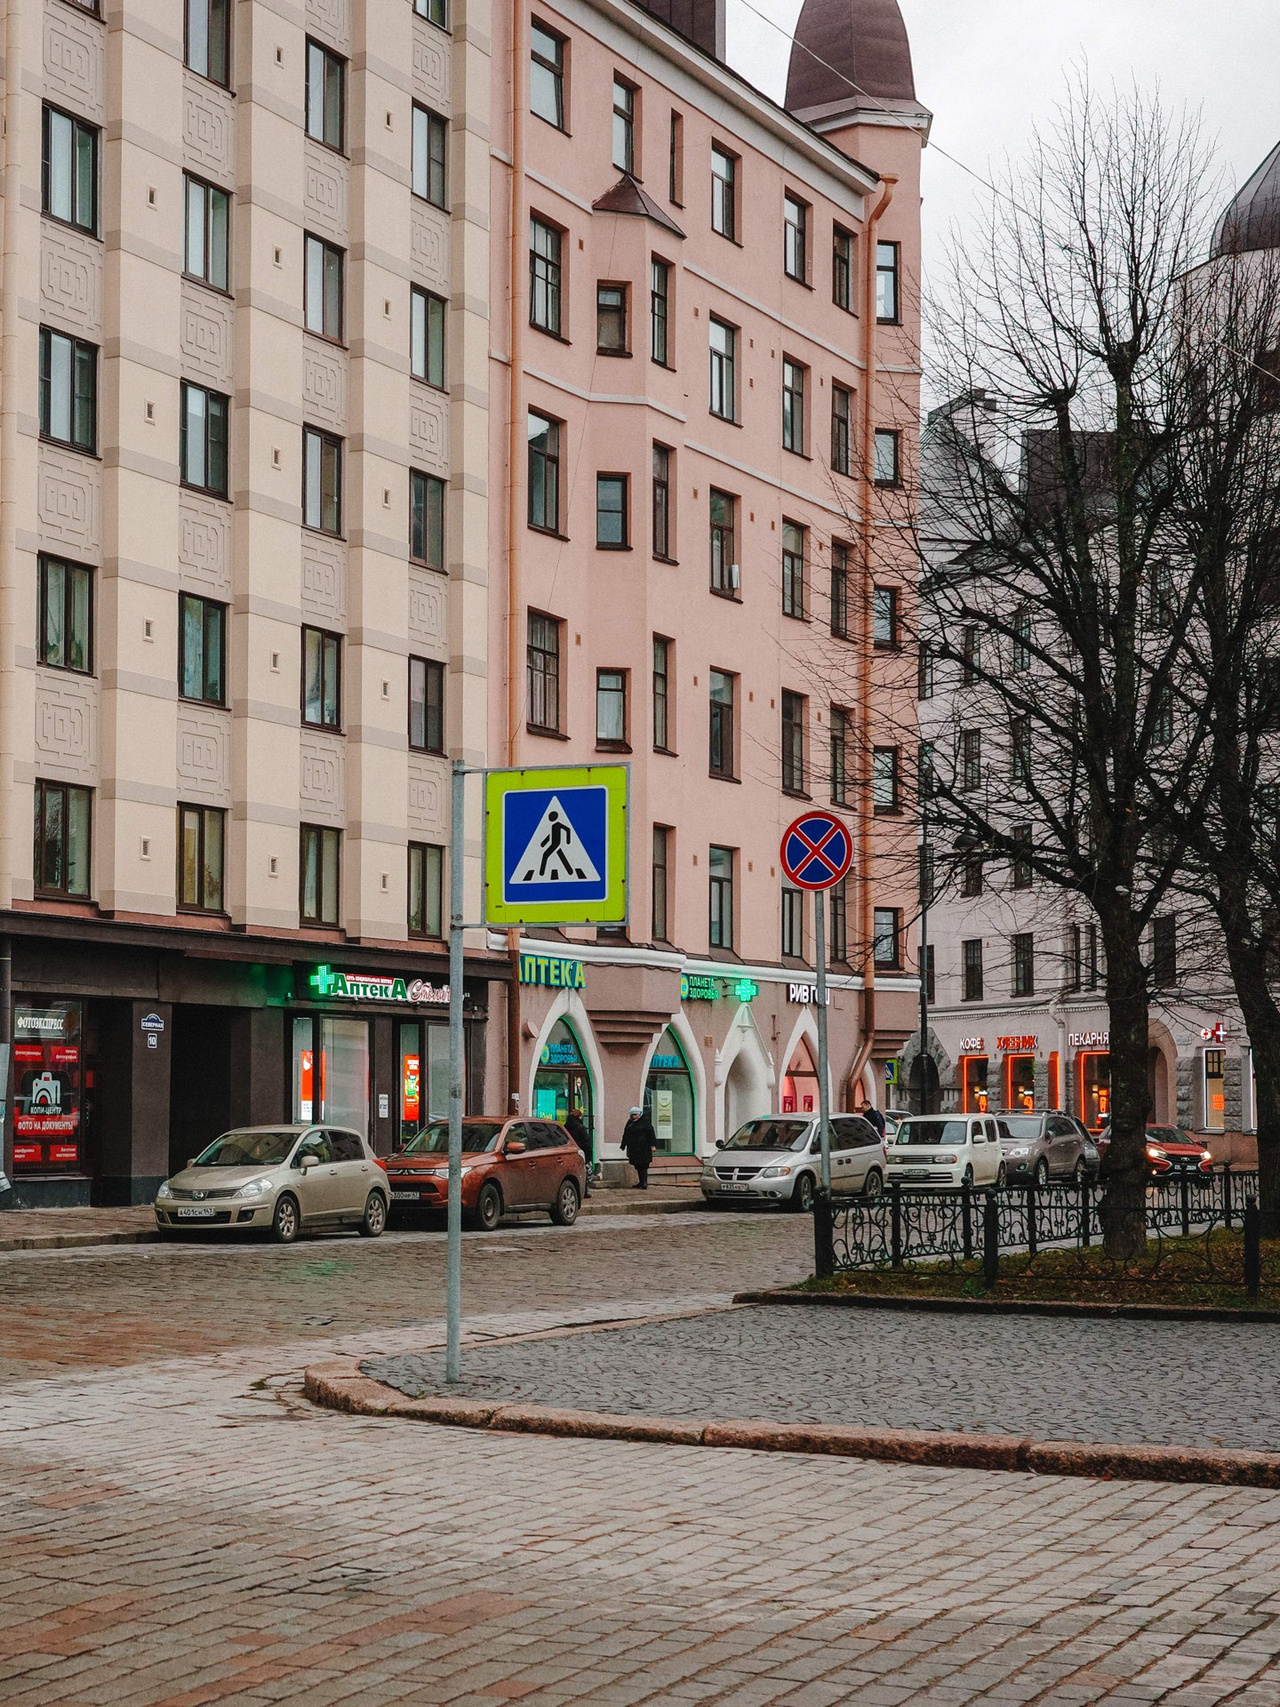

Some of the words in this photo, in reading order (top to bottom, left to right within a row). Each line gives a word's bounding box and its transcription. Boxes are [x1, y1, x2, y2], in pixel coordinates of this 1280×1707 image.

[690, 976, 715, 988] ПЛАНЕТА
[690, 987, 719, 1000] ЗДОРОВЬЯ
[789, 984, 809, 1003] РИВ
[17, 1017, 64, 1030] ФОТОЭКСПРЕСС
[149, 1036, 156, 1046] 10
[960, 1037, 982, 1050] КОФЕ
[1068, 1031, 1109, 1046] ПЕКАРНЯ
[650, 1054, 680, 1068] ПТЕКА
[30, 1106, 63, 1115] КОПИ-ЦЕНТР
[18, 1121, 33, 1130] ФОТО
[34, 1122, 41, 1130] НА
[42, 1121, 73, 1131] ДОКУМЕНТЫ
